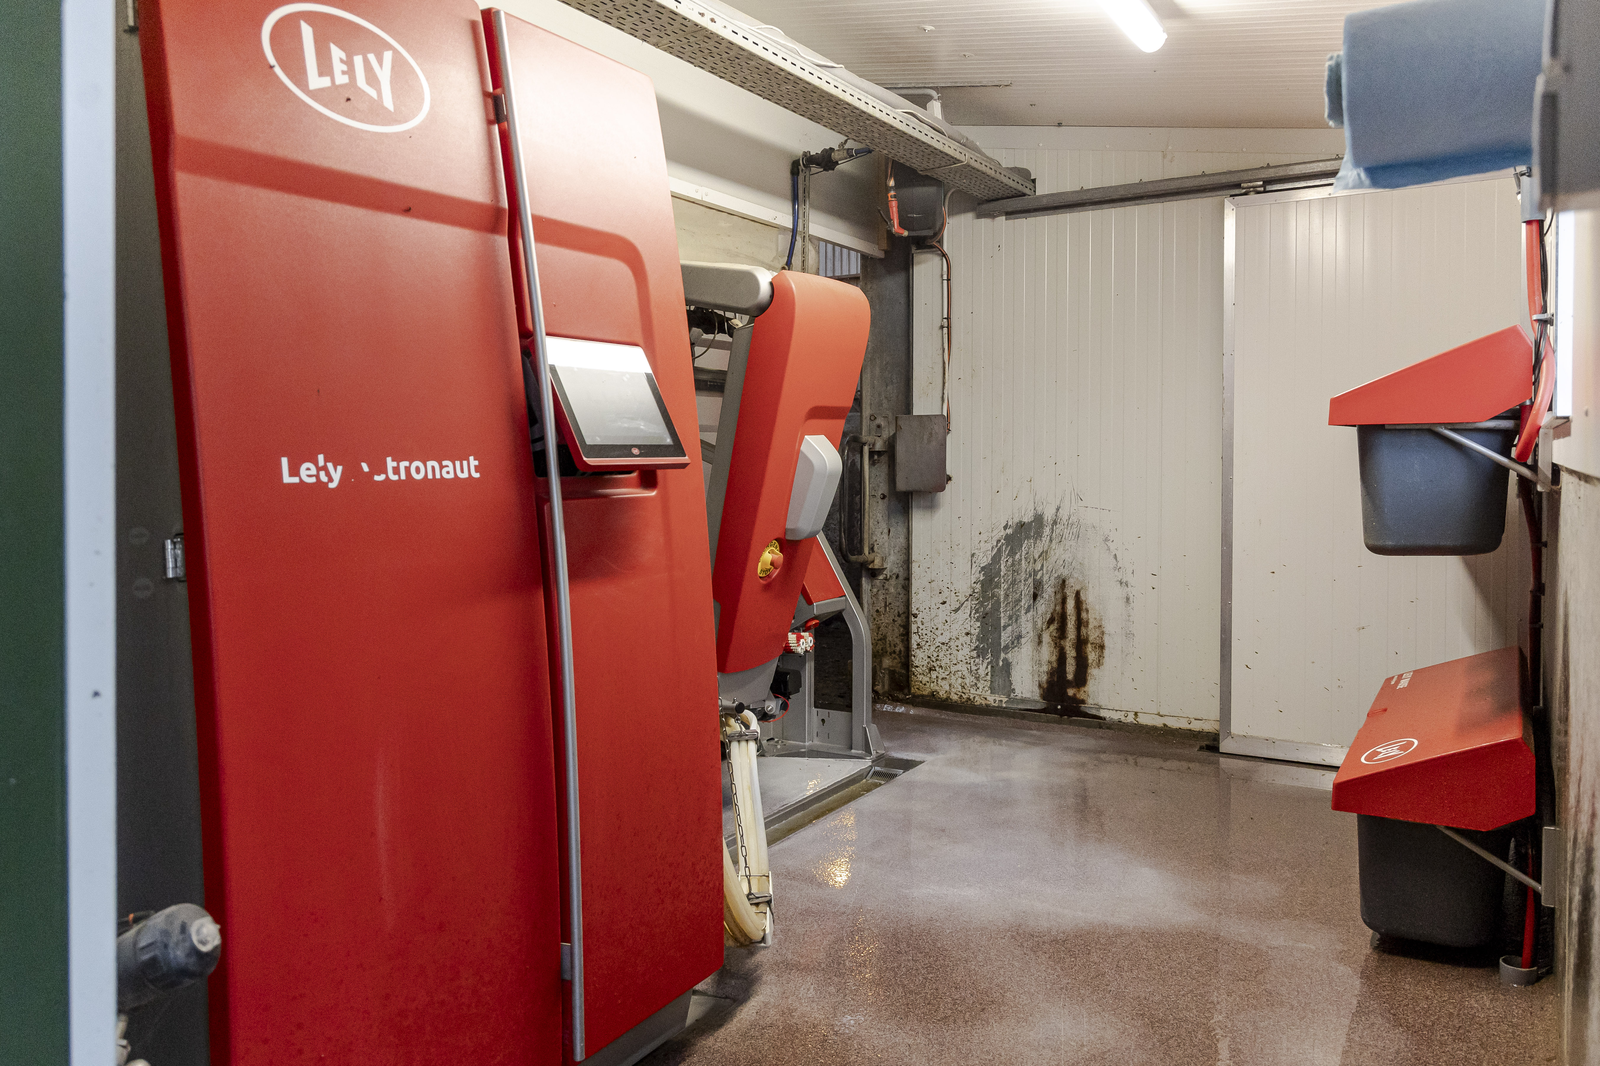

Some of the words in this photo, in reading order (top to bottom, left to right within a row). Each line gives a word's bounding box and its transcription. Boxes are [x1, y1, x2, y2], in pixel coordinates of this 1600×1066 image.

[300, 19, 394, 113] LELY
[280, 453, 343, 489] Lely
[360, 455, 481, 482] tronaut
